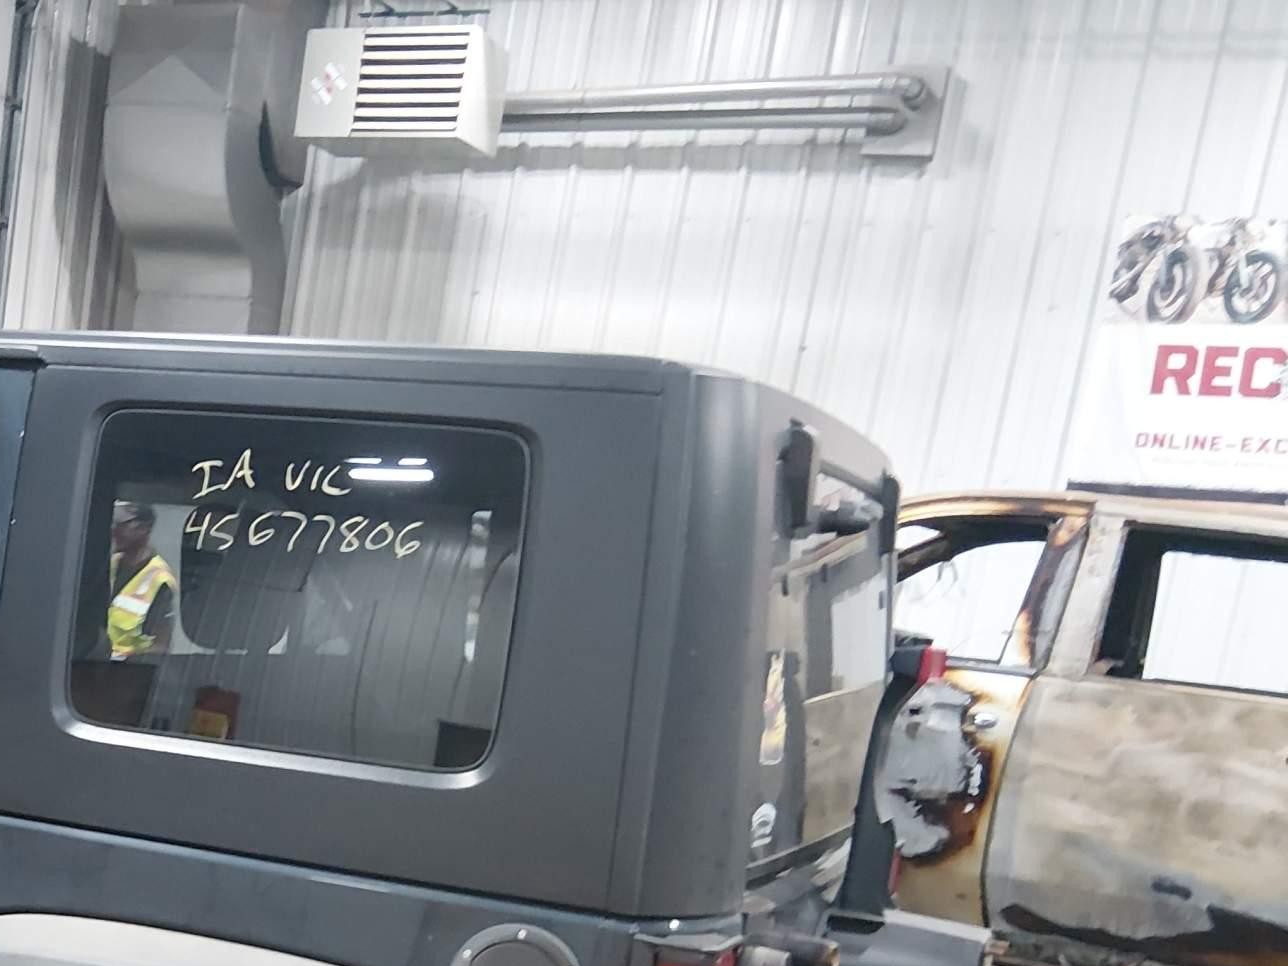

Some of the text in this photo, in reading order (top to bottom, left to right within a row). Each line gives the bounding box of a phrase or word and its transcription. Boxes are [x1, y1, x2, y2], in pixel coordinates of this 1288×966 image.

[1150, 344, 1287, 399] REC
[192, 448, 255, 499] IA
[184, 510, 424, 559] 45677806
